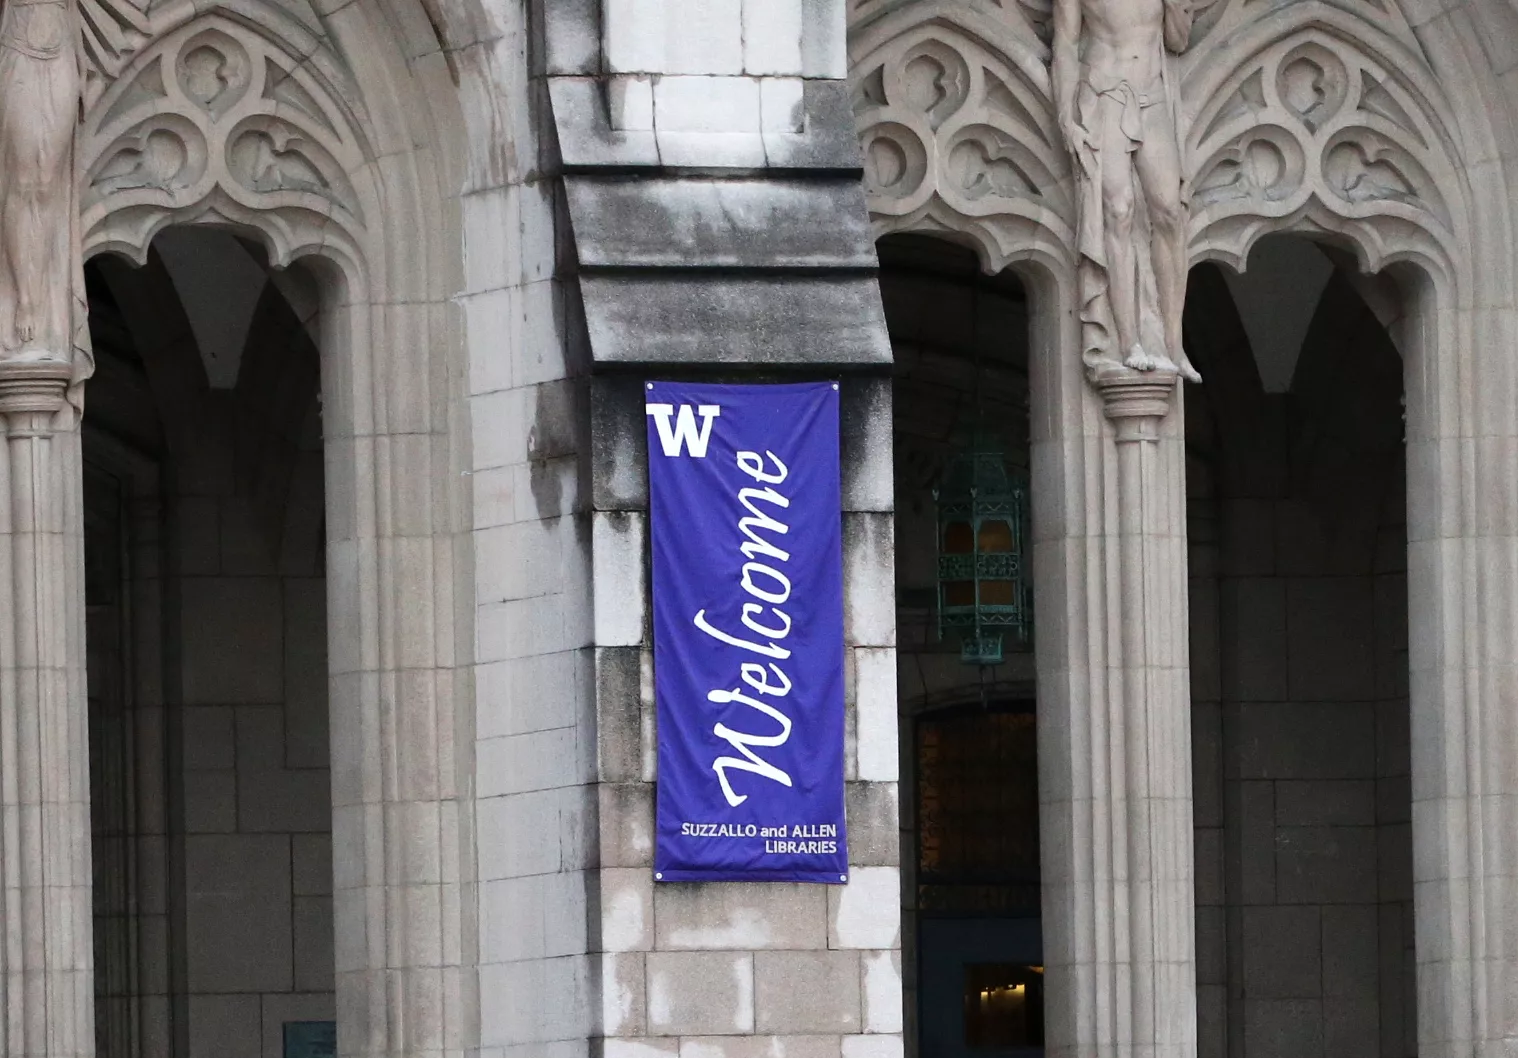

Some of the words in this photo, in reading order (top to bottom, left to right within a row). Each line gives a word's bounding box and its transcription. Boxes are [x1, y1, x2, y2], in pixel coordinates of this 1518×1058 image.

[646, 403, 721, 458] W
[693, 449, 793, 807] Welcome
[681, 822, 758, 839] SUZZALLO
[759, 823, 787, 839] and
[791, 823, 837, 839] ALLEN
[765, 840, 837, 855] LIBRARIES
